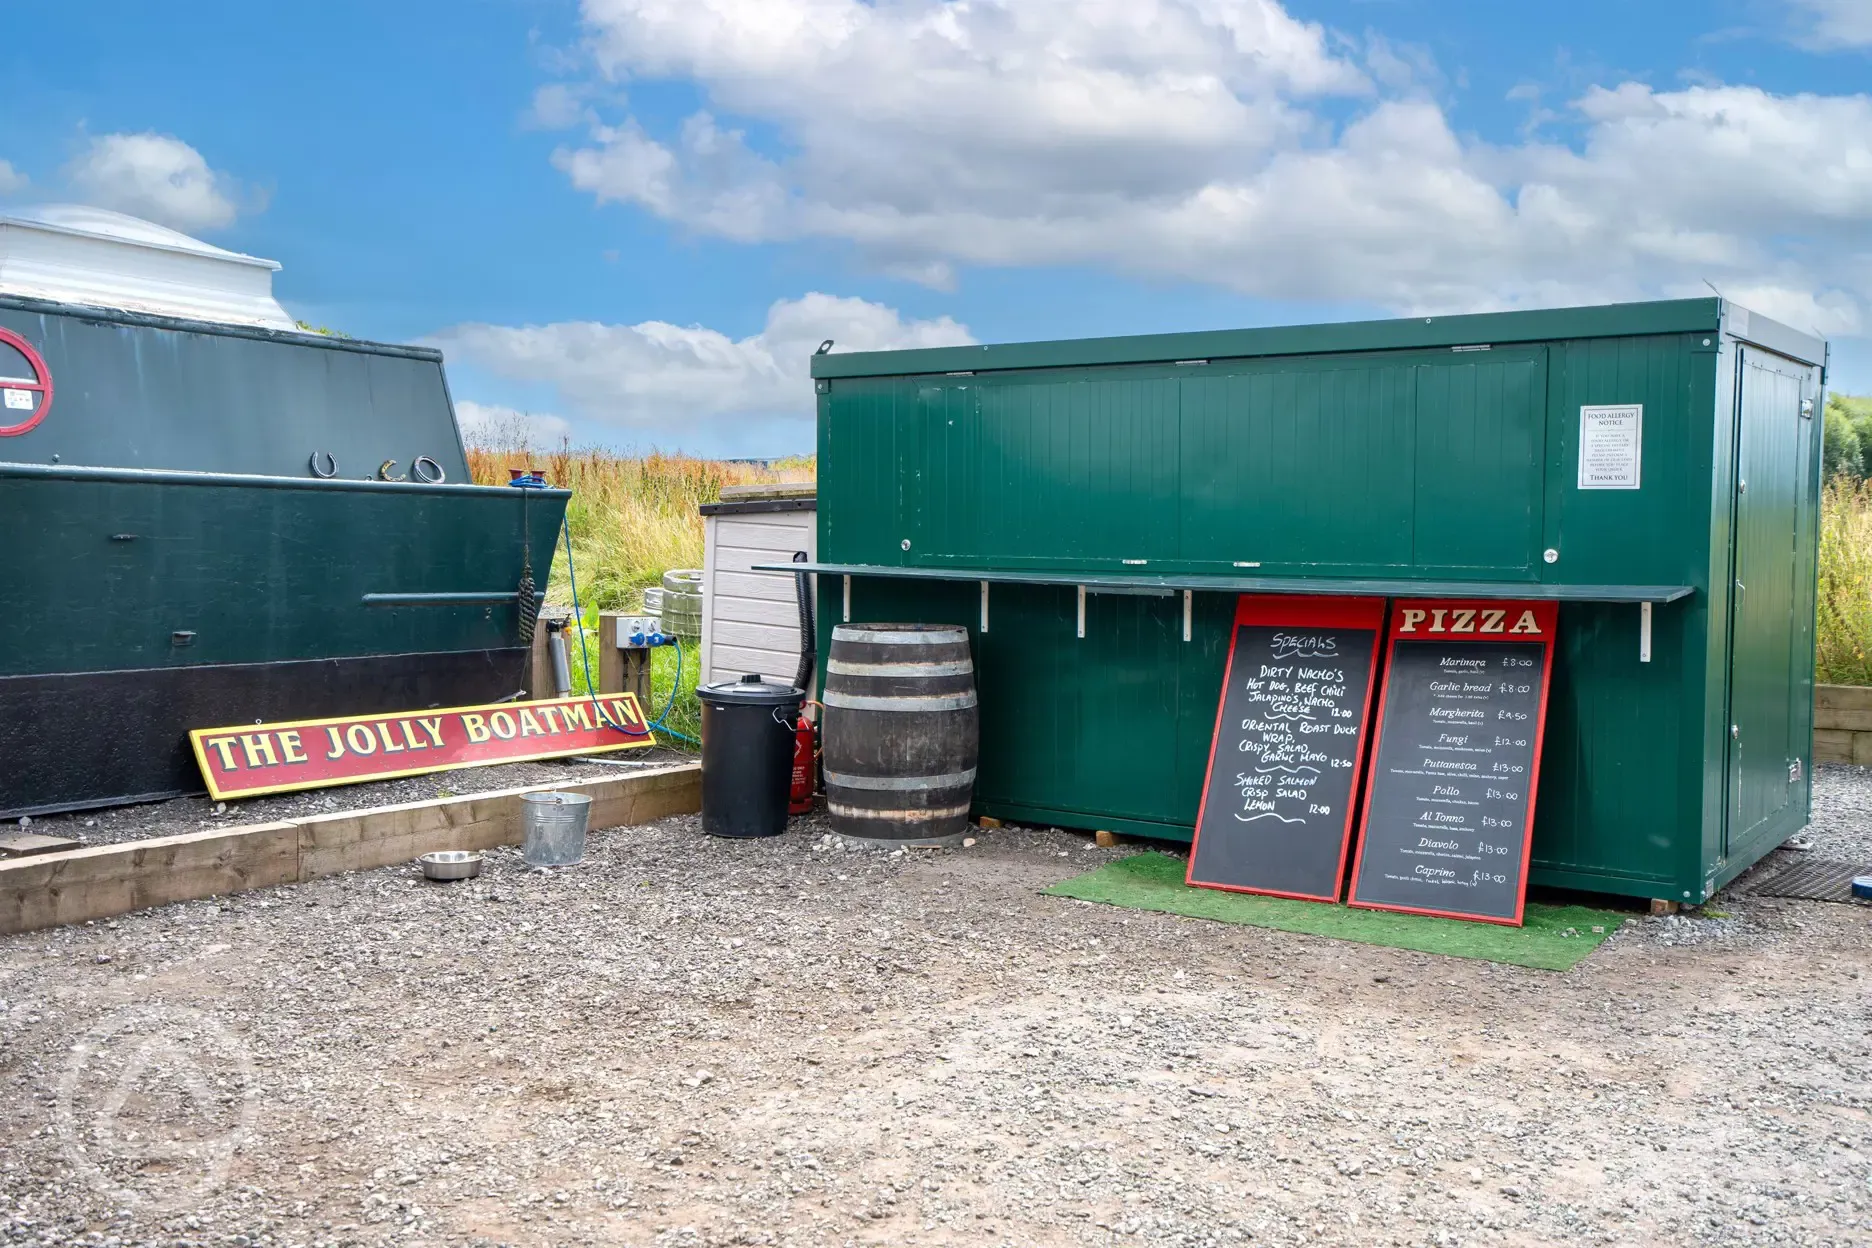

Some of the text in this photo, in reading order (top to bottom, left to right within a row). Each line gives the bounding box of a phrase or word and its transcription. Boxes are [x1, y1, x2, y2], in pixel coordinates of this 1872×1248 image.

[1399, 609, 1542, 634] PIZZA
[1439, 657, 1486, 667] Marinara
[1260, 665, 1344, 682] DIRTY NACHO'S
[1246, 678, 1265, 690] HOT
[1429, 681, 1461, 692] Garlic
[1462, 682, 1492, 693] bread
[1303, 697, 1335, 708] NACHO
[1429, 707, 1485, 719] Margherita
[1241, 719, 1357, 735] ORIENTAL ROAST DUCK
[207, 698, 640, 772] THE JOLLY BOATMAN
[1438, 733, 1469, 746] Fungi
[1300, 752, 1328, 762] MAYO
[1234, 772, 1318, 786] SMOKED SALMON
[1276, 787, 1307, 800] SALAD
[1432, 785, 1460, 797] Pollo
[1244, 798, 1276, 811] LEMON
[1419, 811, 1432, 821] Al
[1434, 812, 1465, 824] Tonno
[1418, 837, 1460, 850] Diavolo
[1414, 864, 1456, 879] Caprino
